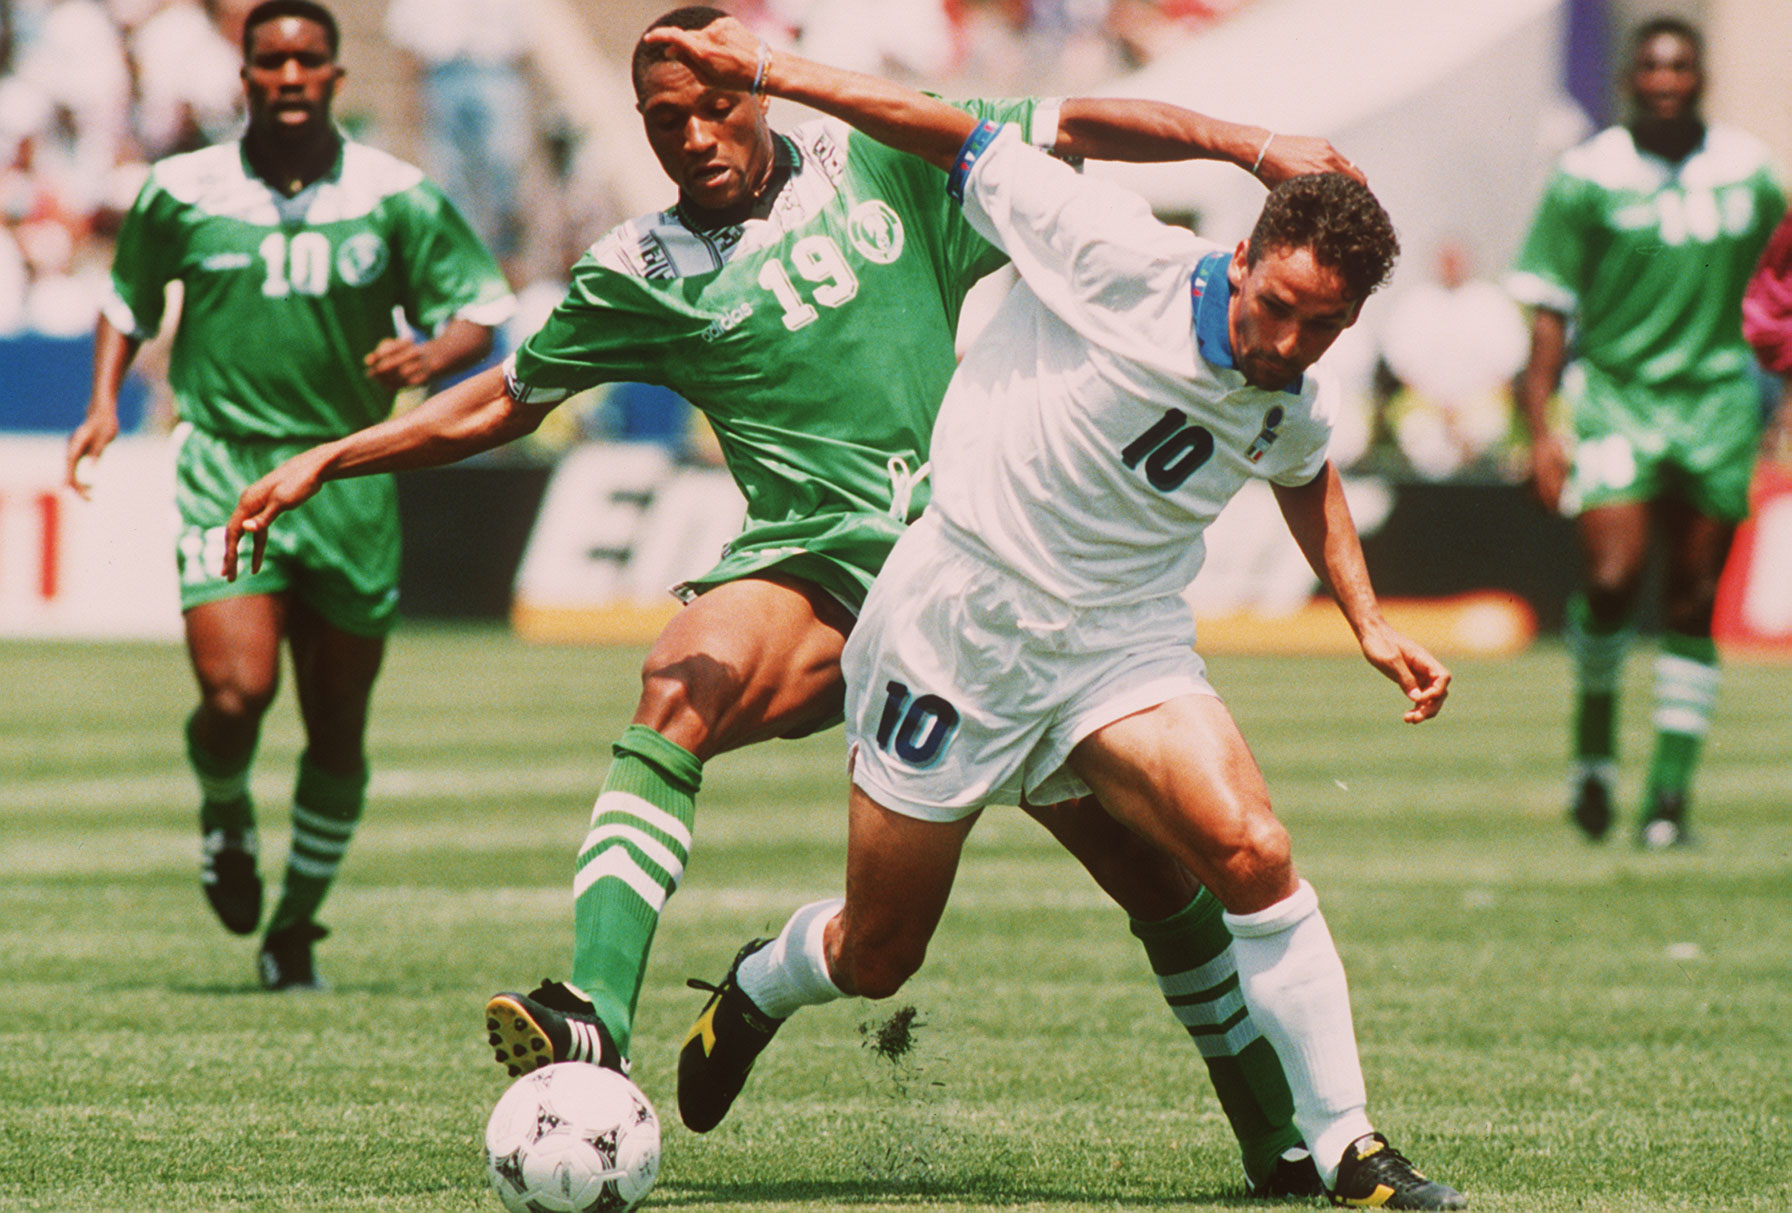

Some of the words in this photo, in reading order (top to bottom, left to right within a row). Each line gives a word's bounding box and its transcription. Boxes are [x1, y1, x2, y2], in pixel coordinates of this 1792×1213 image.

[259, 232, 331, 297] 10
[758, 235, 859, 331] 19
[701, 303, 753, 342] adidas
[1121, 408, 1215, 493] 10
[877, 680, 961, 768] 10
